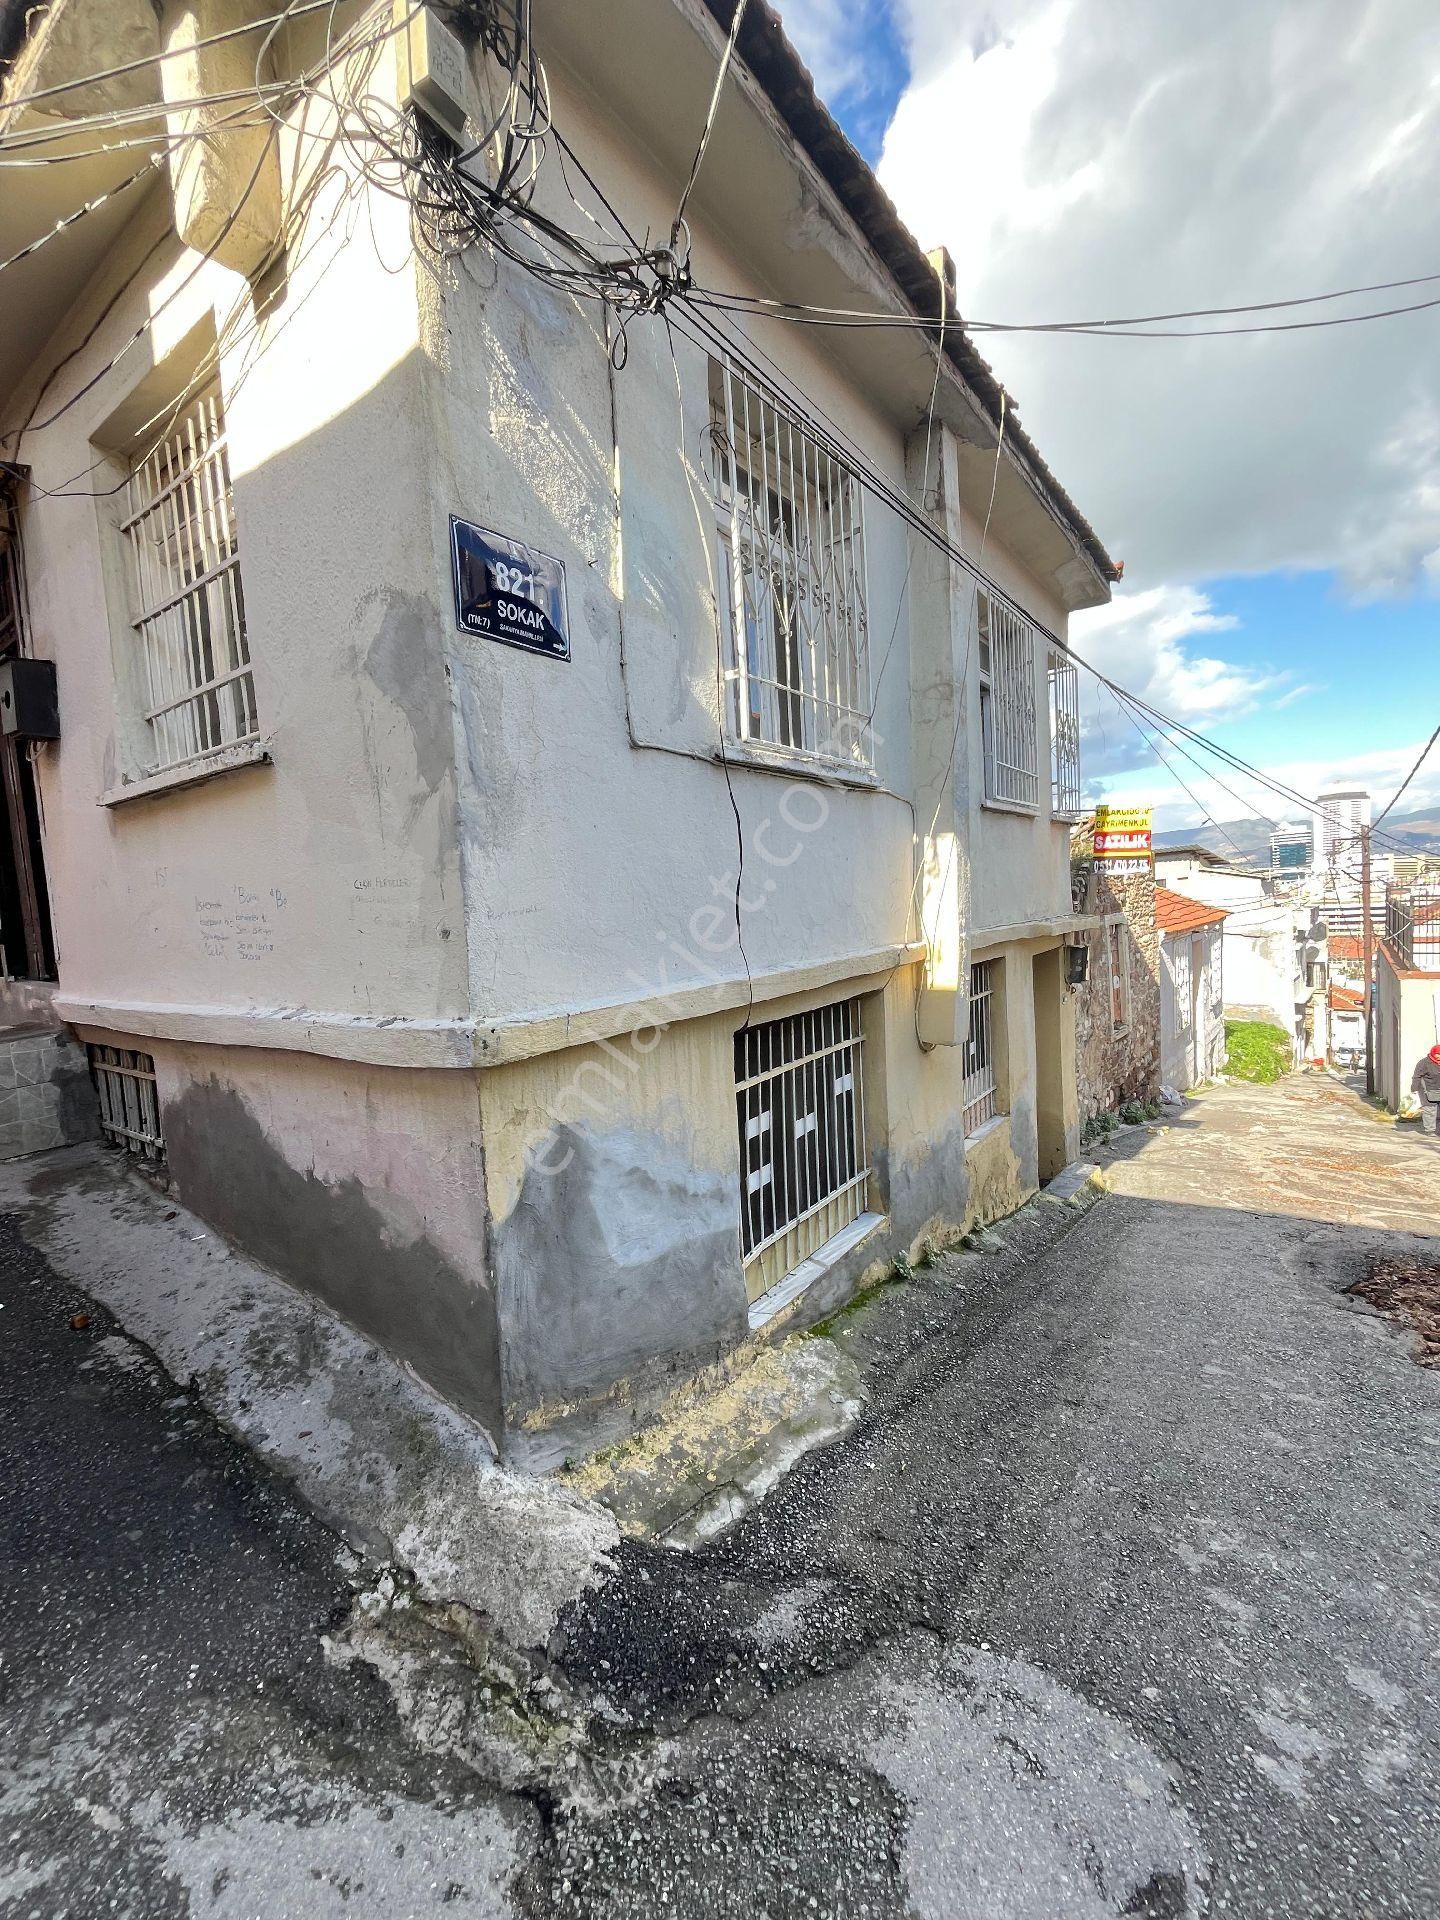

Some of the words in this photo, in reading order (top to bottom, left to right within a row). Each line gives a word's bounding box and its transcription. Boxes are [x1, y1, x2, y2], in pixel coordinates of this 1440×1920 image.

[495, 562, 535, 601] 821
[498, 600, 545, 631] SOKAK
[1095, 834, 1148, 849] SATILIK
